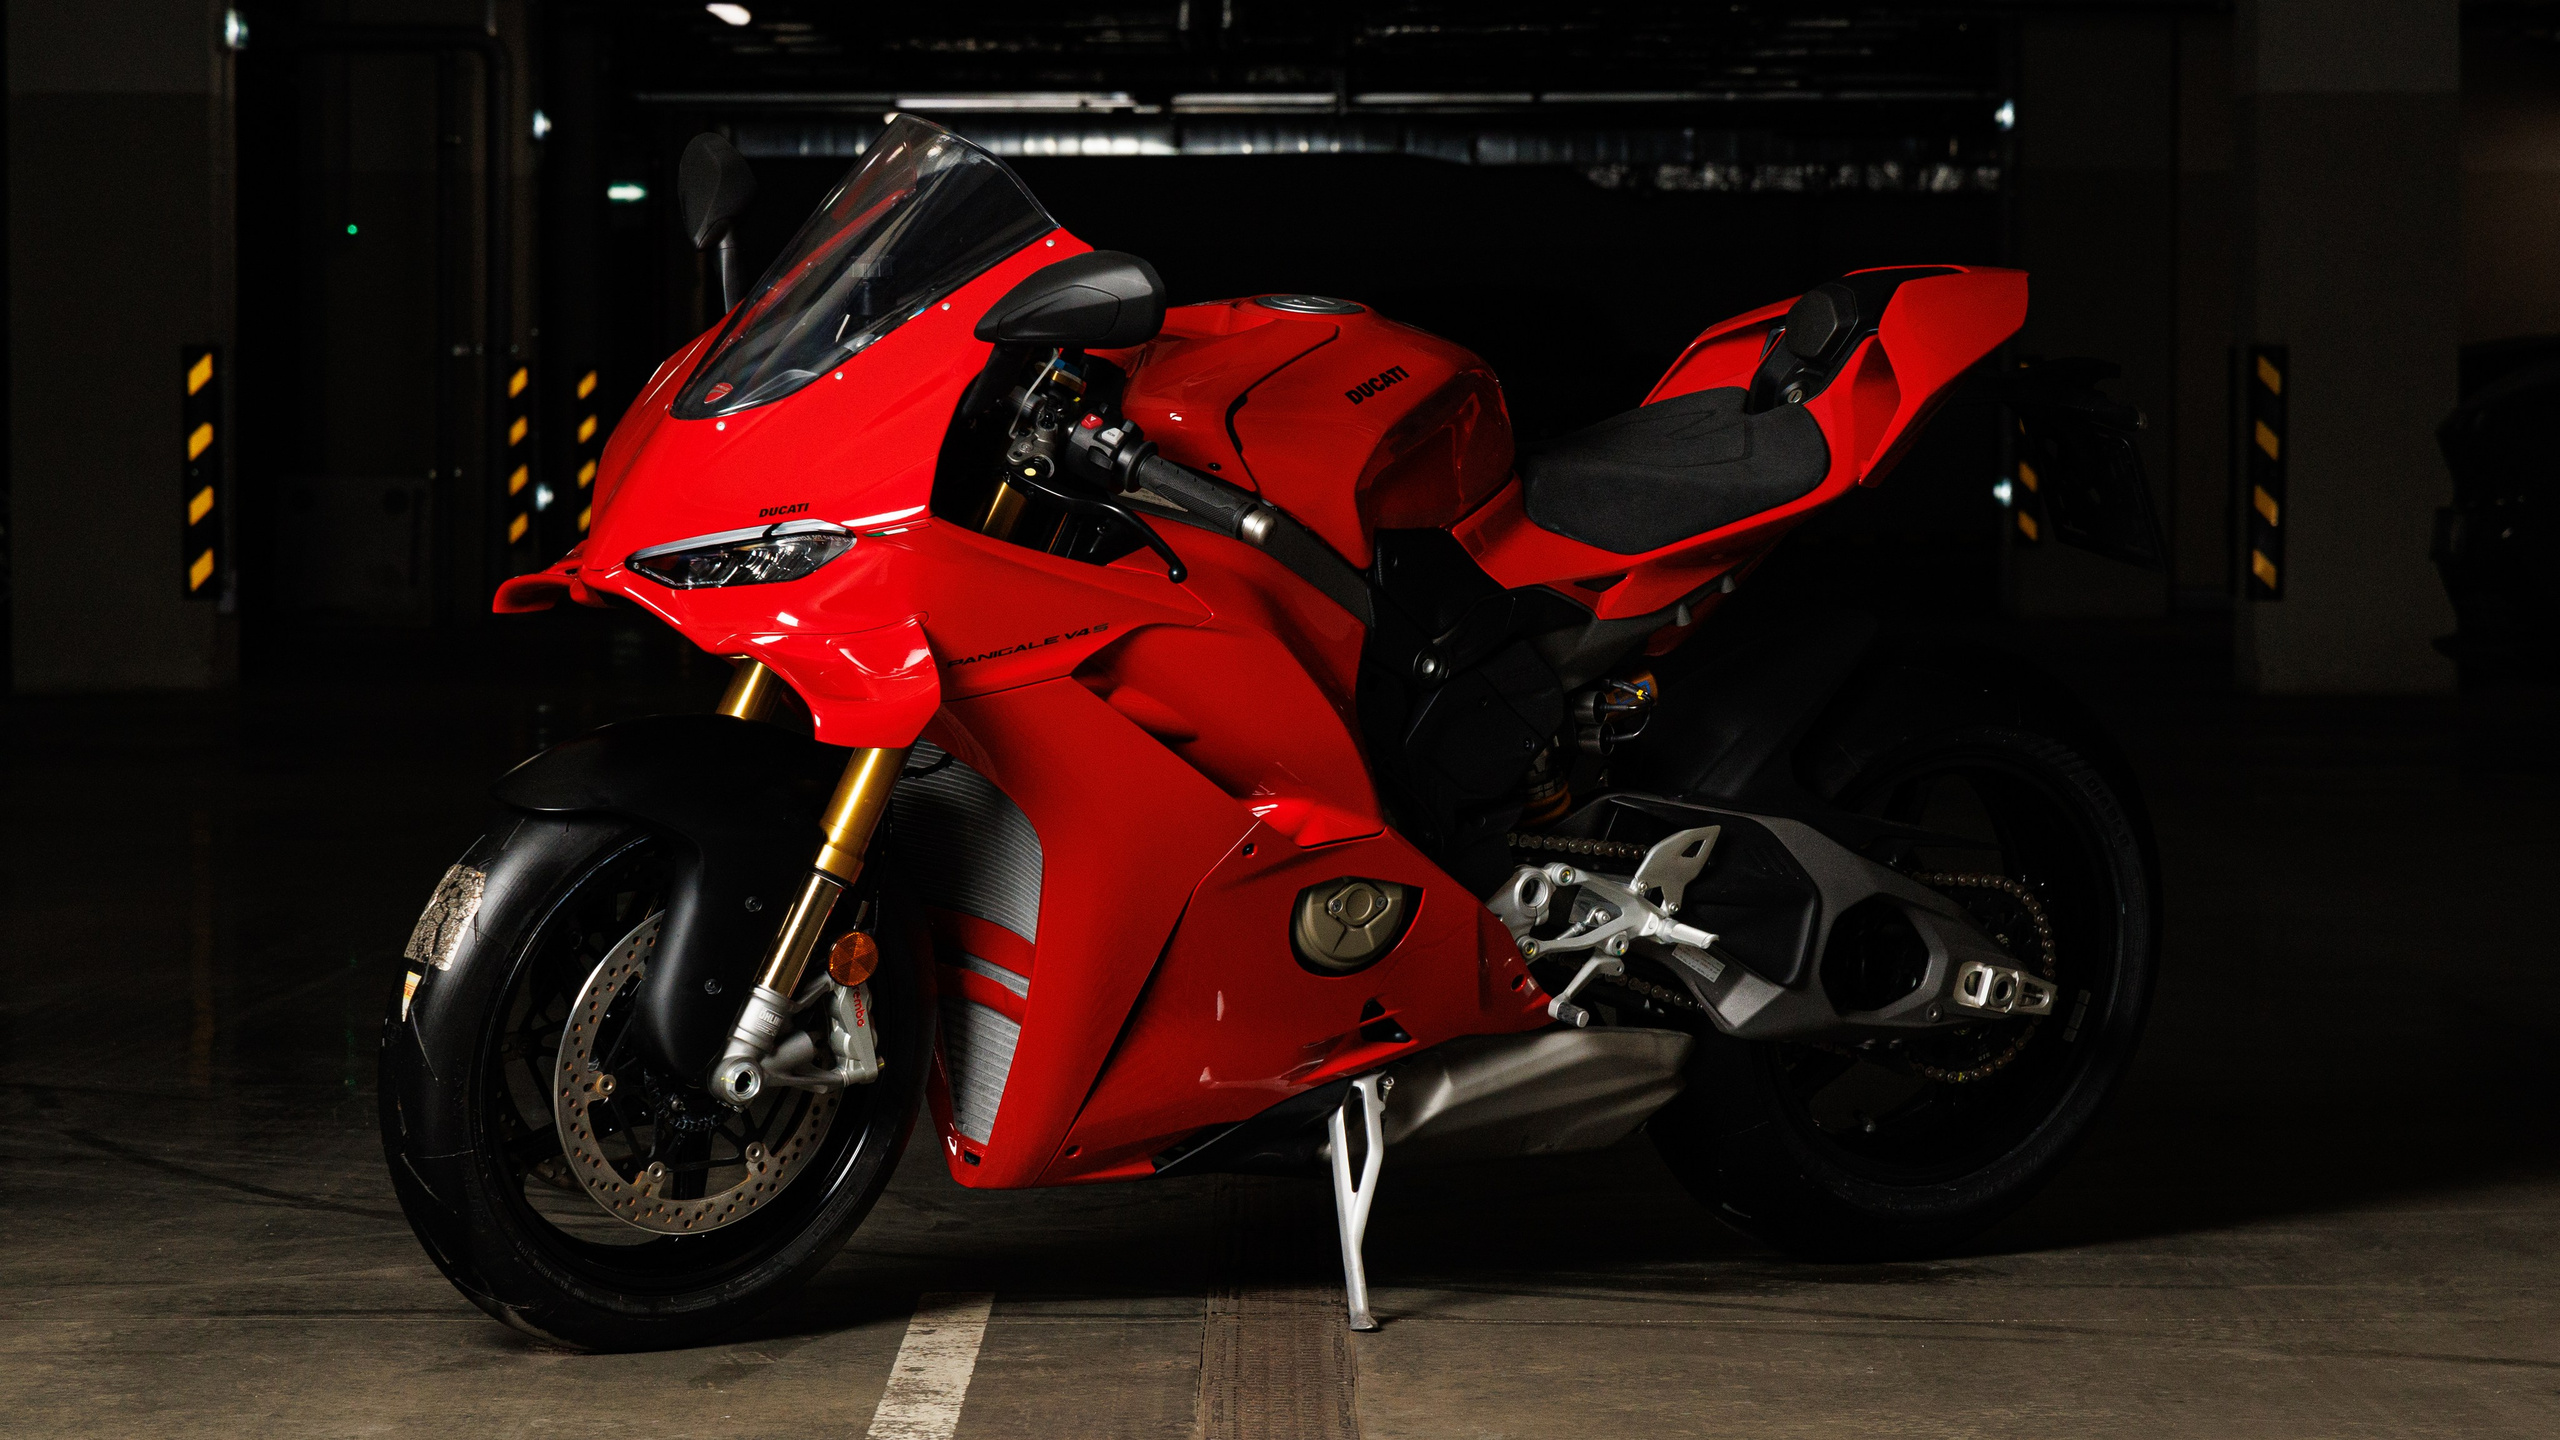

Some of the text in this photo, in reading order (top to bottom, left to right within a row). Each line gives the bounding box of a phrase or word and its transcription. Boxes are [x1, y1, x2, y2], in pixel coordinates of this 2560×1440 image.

[1344, 365, 1410, 405] DUCATI
[759, 502, 810, 518] DUCATI
[947, 635, 1060, 668] PANIGALE
[852, 985, 866, 1028] rembo
